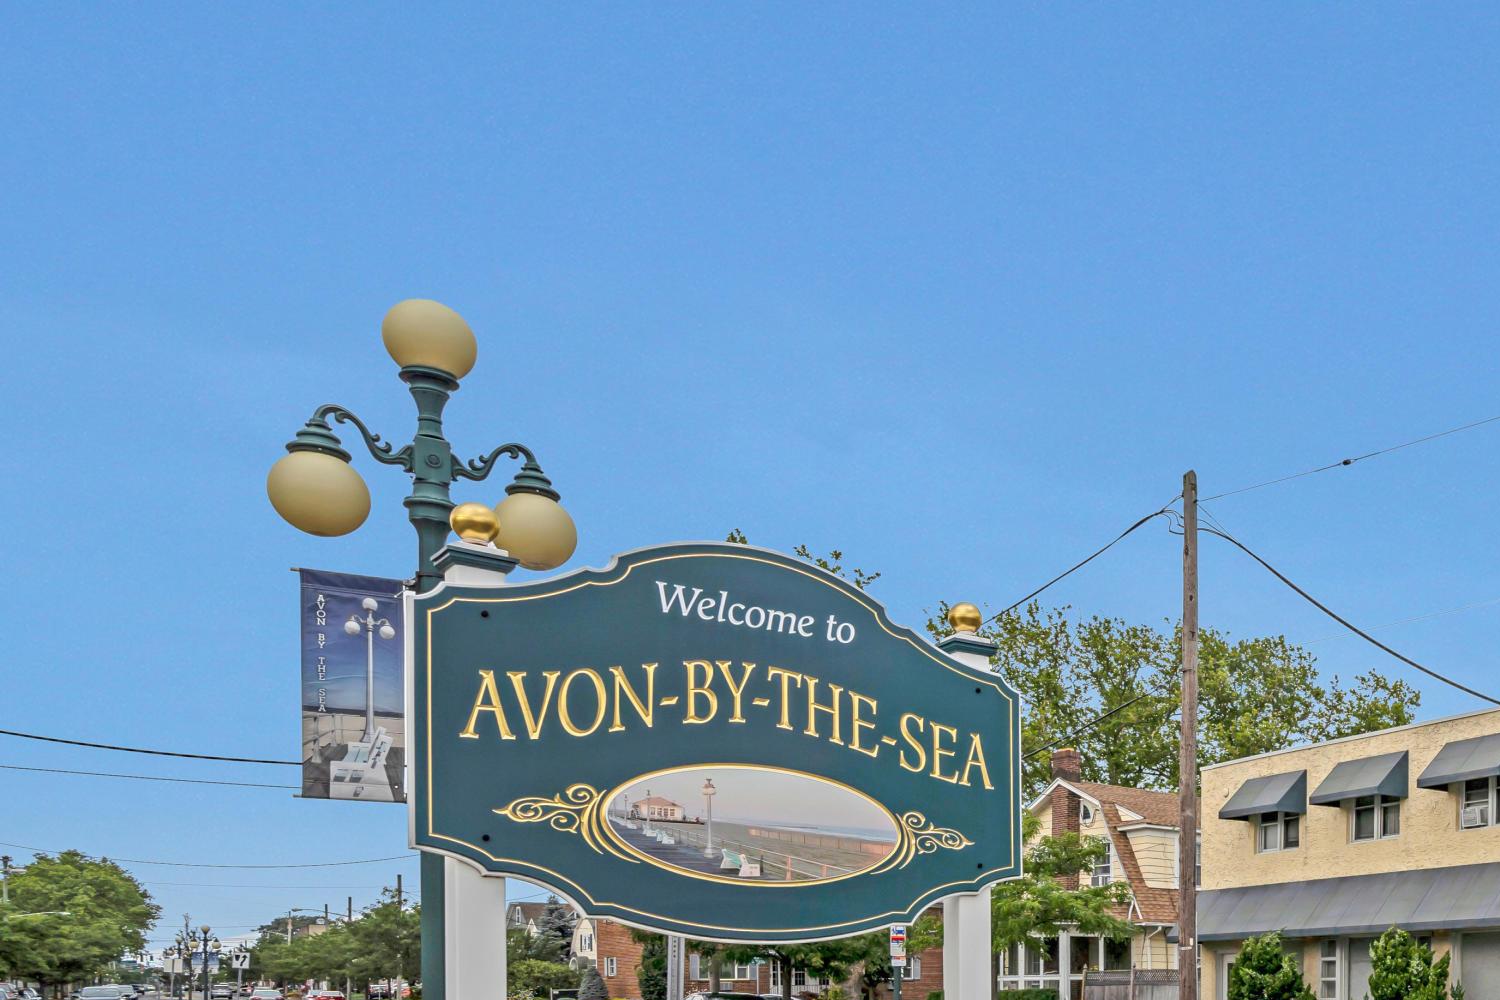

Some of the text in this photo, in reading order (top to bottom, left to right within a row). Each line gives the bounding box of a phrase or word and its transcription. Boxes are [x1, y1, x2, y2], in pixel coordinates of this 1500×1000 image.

[316, 594, 327, 713] AVON BY THE SEA
[655, 580, 856, 645] Welcome to
[458, 660, 995, 791] AVON-BY-THE-SEA
